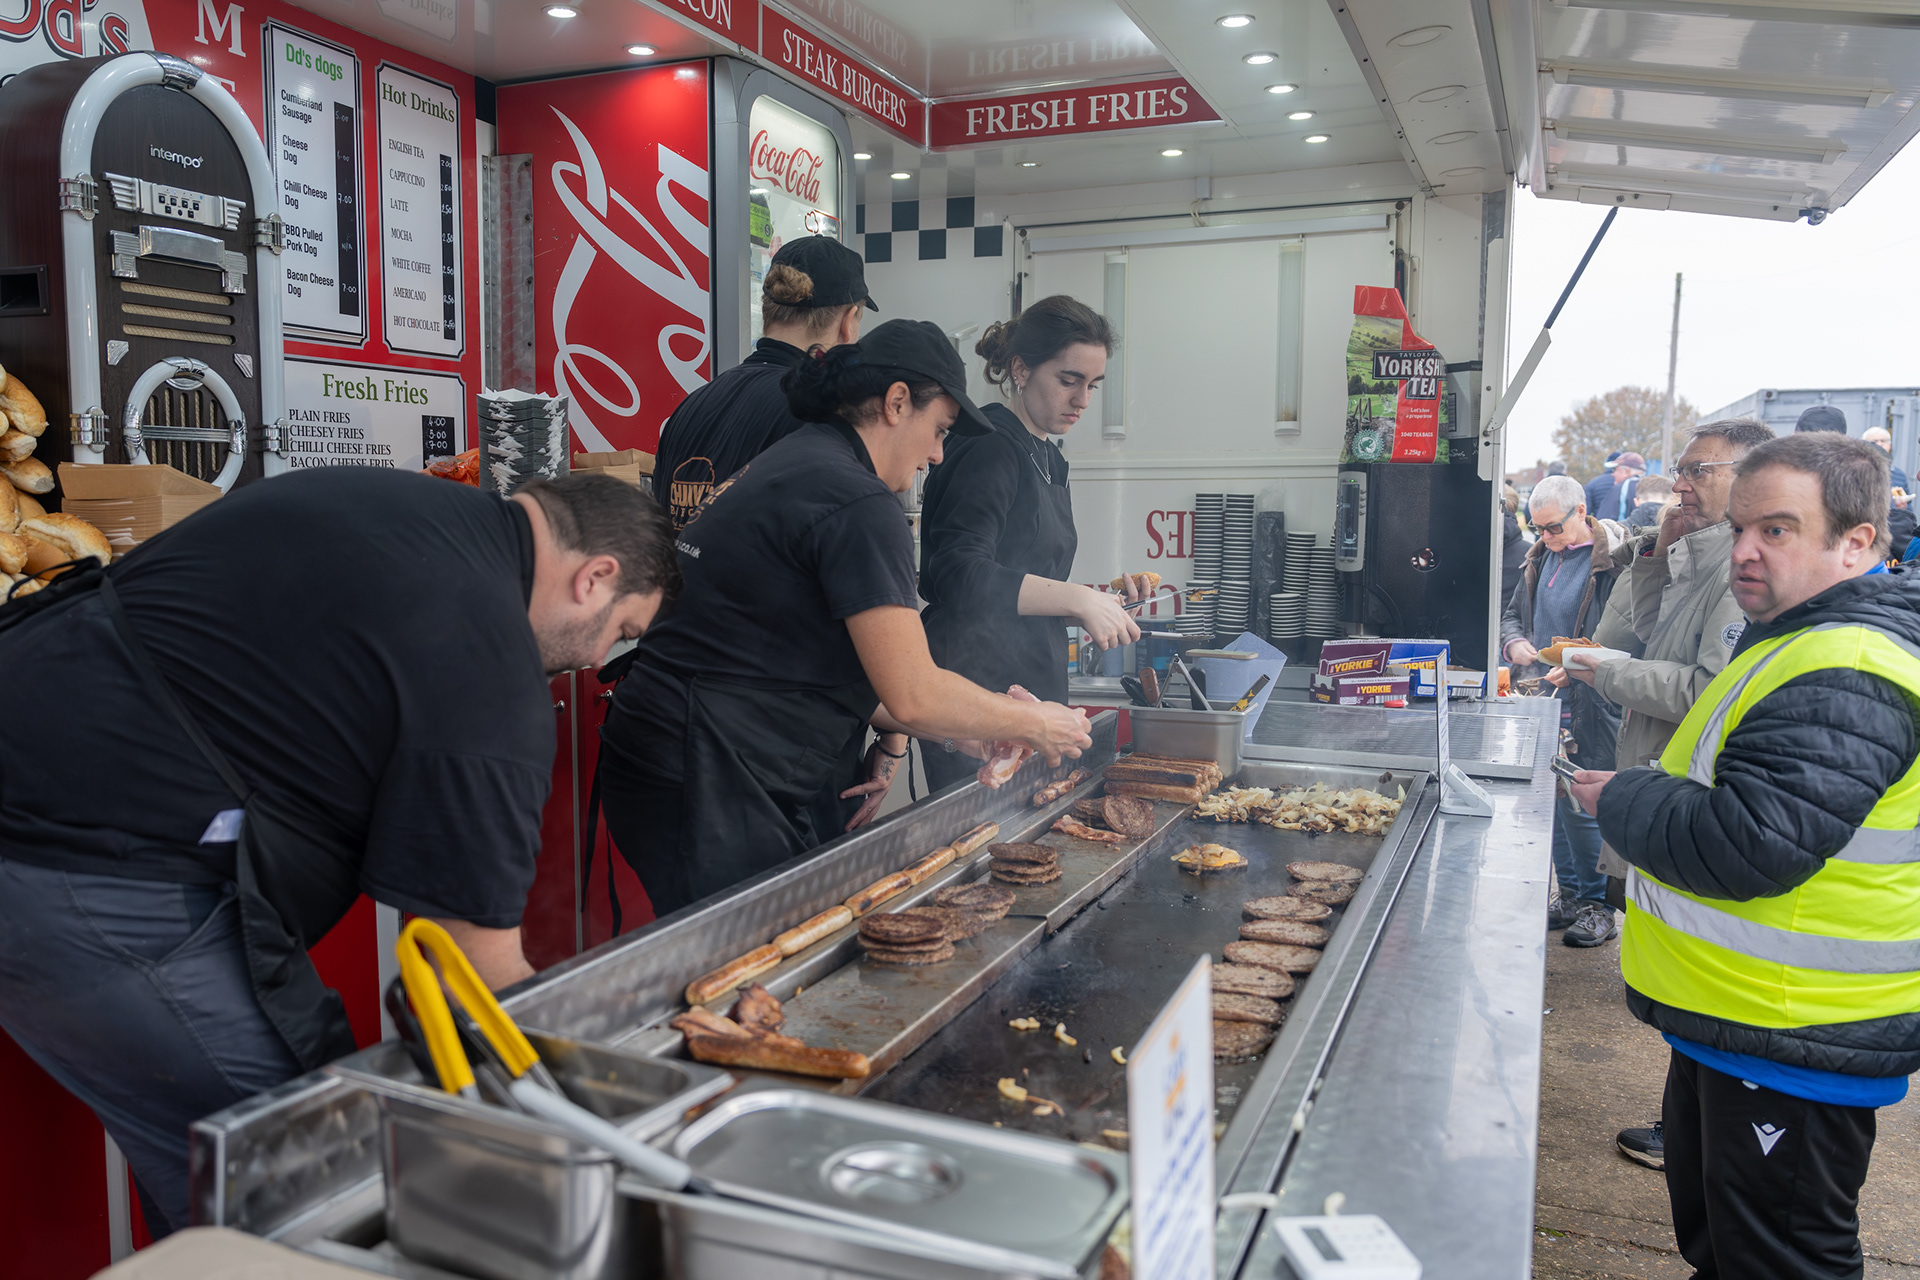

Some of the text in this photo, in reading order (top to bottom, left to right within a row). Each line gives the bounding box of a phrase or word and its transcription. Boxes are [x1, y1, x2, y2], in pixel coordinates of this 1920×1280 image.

[286, 43, 343, 81] Dd's dogs
[783, 28, 906, 128] STEAK BURGERS
[281, 89, 322, 112] Cumberland
[382, 82, 455, 122] Hot Drinks
[282, 105, 312, 124] Sausage
[966, 86, 1188, 136] FRESH FRIES
[283, 135, 308, 151] Cheese
[389, 139, 424, 158] ENGLISH TEA
[150, 144, 200, 168] intempo
[284, 150, 297, 165] Dog
[390, 169, 425, 187] CAPPUCCINO
[303, 184, 327, 199] Cheese
[285, 194, 299, 209] Dog
[391, 198, 408, 212] LATTE
[286, 224, 323, 241] BBQ Pulled
[391, 228, 412, 242] MOCHA
[287, 239, 317, 257] Pork Dog
[392, 257, 431, 274] WHITE COFFEE
[287, 269, 334, 286] Bacon Cheese
[288, 284, 301, 298] Dog
[393, 287, 426, 301] AMERICANO
[394, 315, 440, 332] HOT CHOCOLATE
[322, 373, 428, 404] Fresh Fries
[1410, 378, 1435, 395] TEA
[289, 409, 350, 424] PLAIN FRIES
[290, 425, 364, 439] CHEESEY FRIES
[290, 440, 391, 455] CHILLI CHEESE FRIES
[291, 456, 327, 468] BACON
[370, 459, 394, 469] FRIES
[1334, 660, 1373, 674] YORKIE
[1360, 685, 1391, 694] YORKIE
